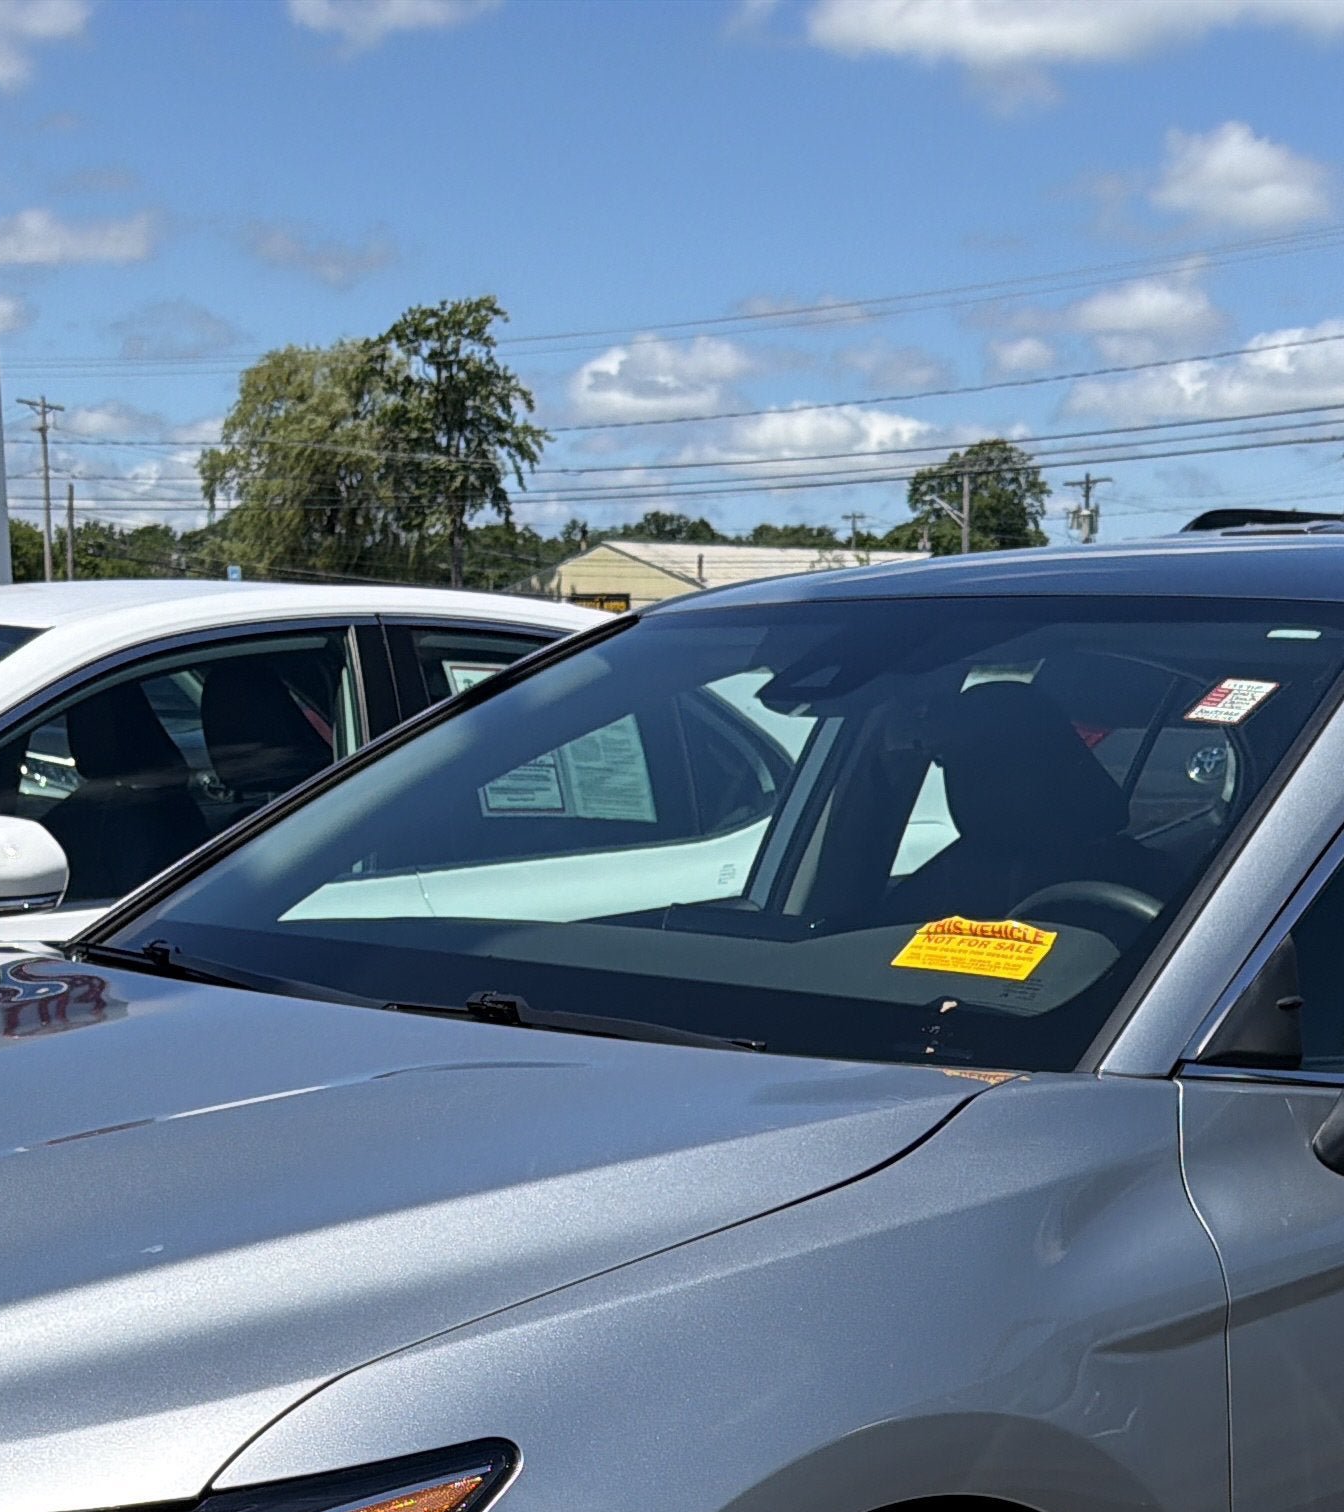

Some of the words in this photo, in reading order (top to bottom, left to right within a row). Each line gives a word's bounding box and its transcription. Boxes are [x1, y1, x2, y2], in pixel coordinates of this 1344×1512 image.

[968, 922, 1046, 945] VEHICLE
[922, 935, 956, 945] NOT
[957, 938, 991, 949] FOR
[994, 941, 1035, 954] SALE
